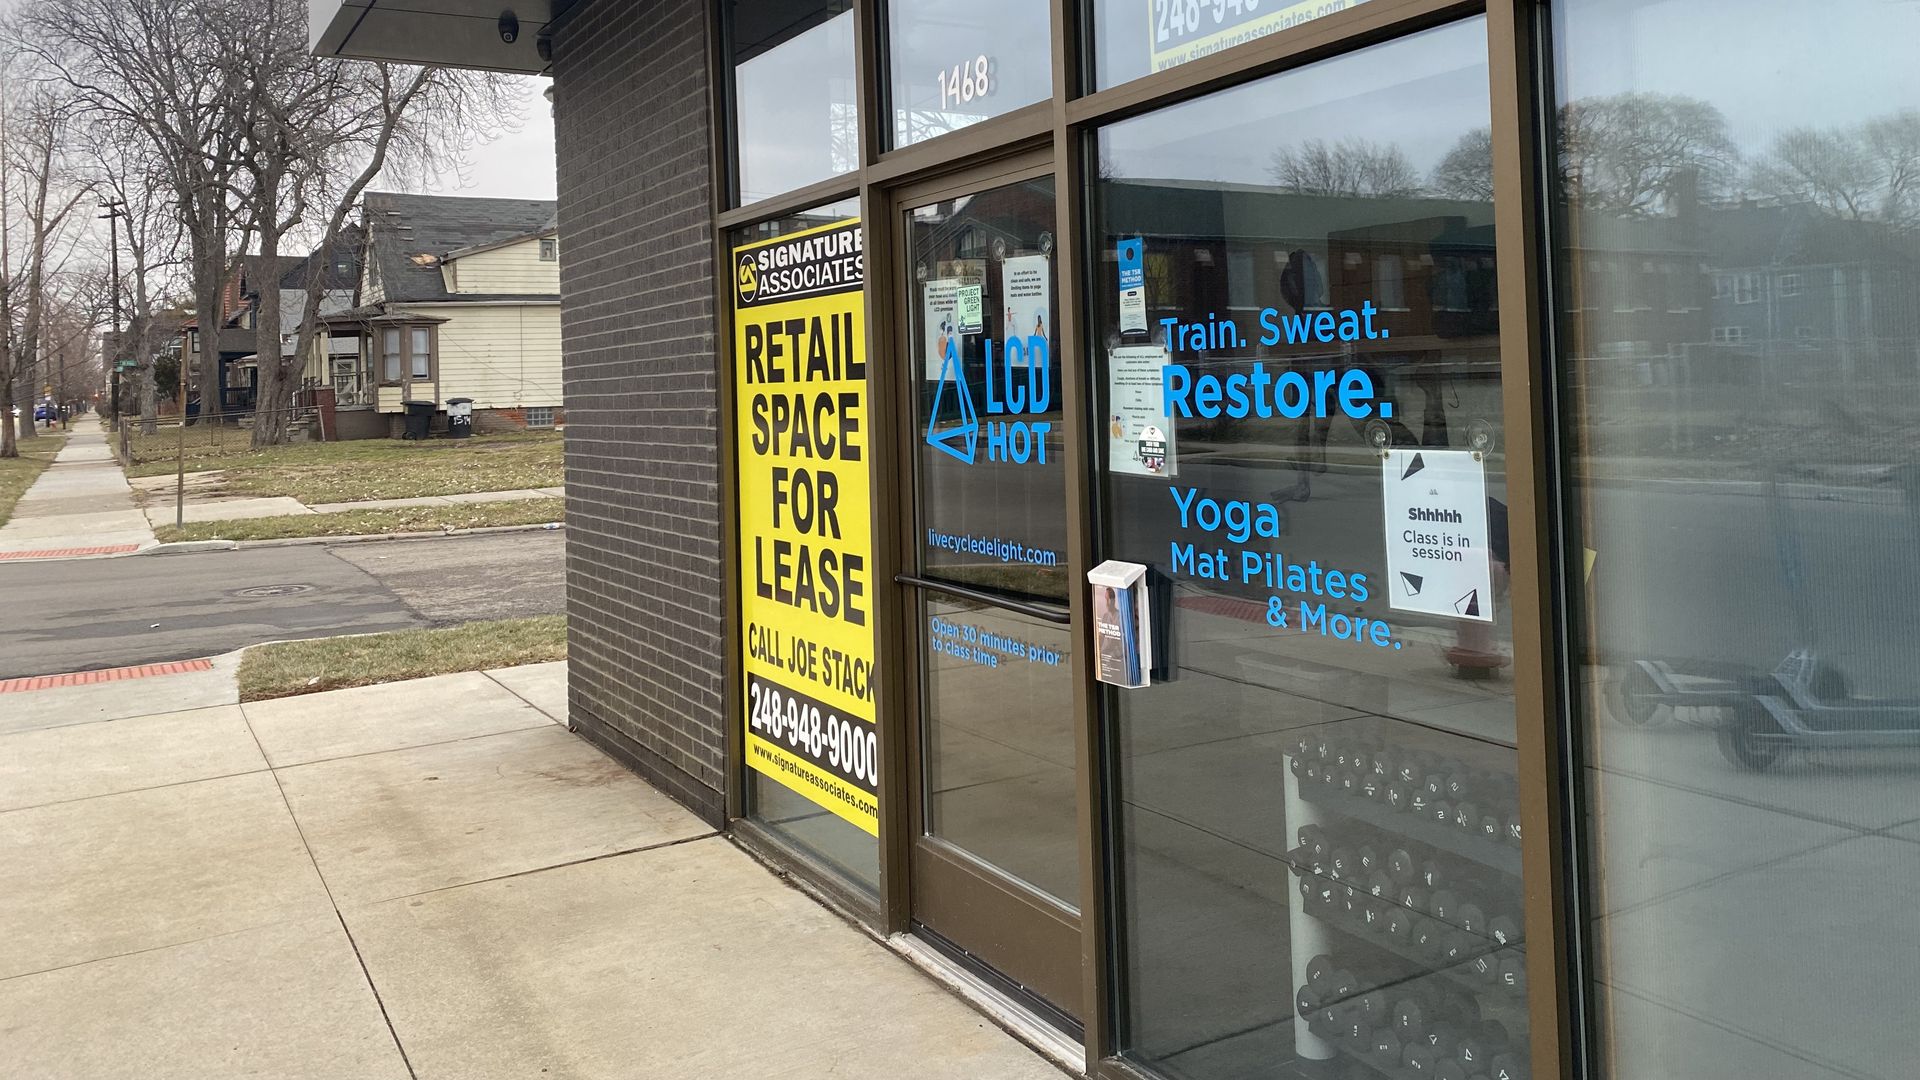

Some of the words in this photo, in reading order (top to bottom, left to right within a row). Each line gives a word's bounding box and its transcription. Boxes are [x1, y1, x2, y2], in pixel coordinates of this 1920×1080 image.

[938, 54, 989, 110] 1468
[758, 228, 863, 271] SIGNATURE
[759, 255, 864, 295] ASSOCIATES
[958, 287, 980, 297] PROJECT
[963, 296, 980, 305] GREEN
[966, 304, 980, 313] LIGHT
[745, 312, 866, 384] RETAIL
[1160, 312, 1247, 352] Train.
[1260, 300, 1389, 346] Sweat.
[985, 336, 1050, 414] LCD
[1162, 362, 1393, 419] Restore.
[752, 392, 861, 461] SPACE
[987, 421, 1051, 465] HOT
[772, 467, 841, 539] FOR
[1169, 487, 1280, 543] Yoga
[1408, 507, 1463, 524] Shhhhh
[928, 528, 1057, 566] livecycledelight.com
[1403, 530, 1439, 546] Class
[1443, 533, 1453, 547] is
[1458, 534, 1470, 548] in
[1412, 547, 1463, 562] session
[755, 535, 865, 627] LEASE
[1171, 542, 1229, 581] Mat
[1242, 551, 1369, 602] Pilates
[931, 617, 960, 639] Open
[962, 625, 977, 643] 30
[980, 631, 1026, 657] minutes
[1029, 643, 1061, 666] prior
[1266, 595, 1288, 629] &
[1300, 600, 1402, 650] More.
[749, 622, 784, 668] CALL
[788, 636, 818, 682] JOE
[822, 646, 876, 703] STACK
[932, 636, 943, 651] to
[945, 641, 970, 661] class
[973, 649, 998, 668] time
[751, 682, 878, 787] 248-948-9000
[753, 743, 878, 820] www.signatureassociates.com
